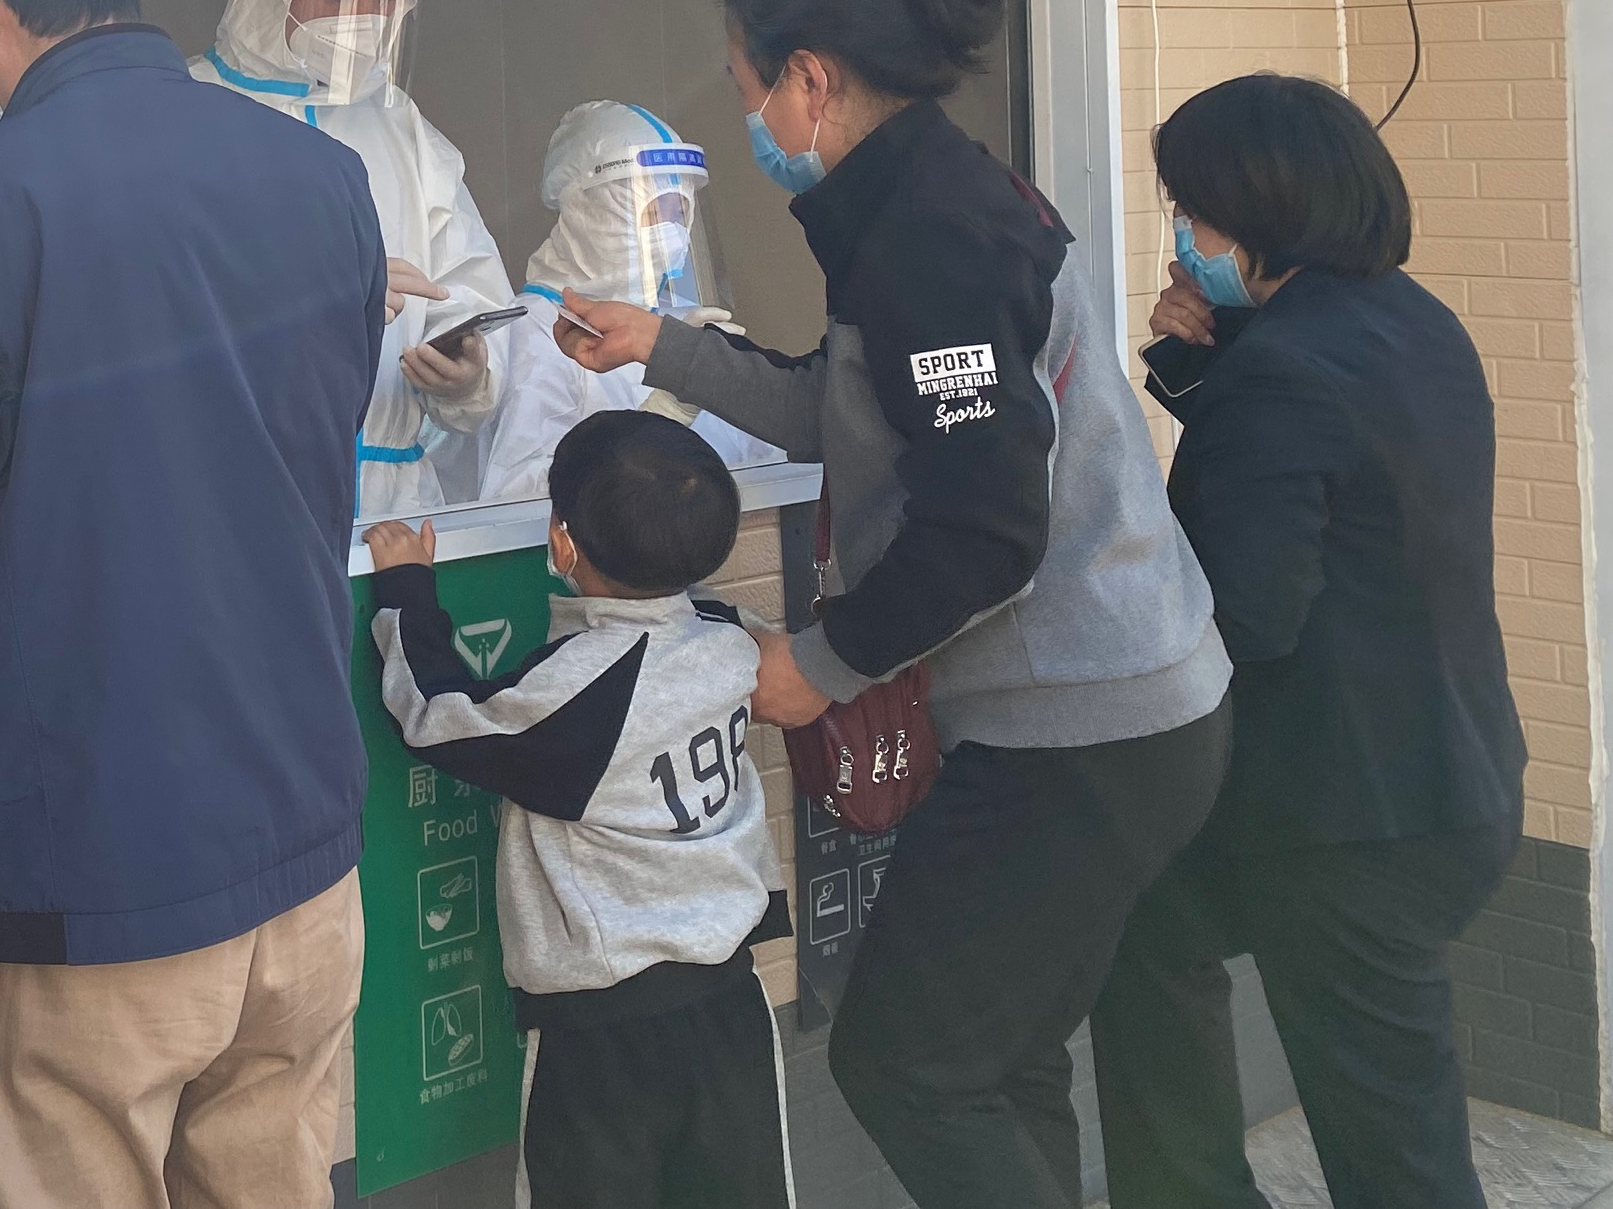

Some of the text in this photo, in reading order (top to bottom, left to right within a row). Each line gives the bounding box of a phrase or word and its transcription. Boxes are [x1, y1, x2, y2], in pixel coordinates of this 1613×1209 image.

[918, 349, 984, 376] SPORT
[916, 371, 999, 396] MINGRENHAI
[933, 396, 996, 434] Sports
[423, 808, 478, 847] Food
